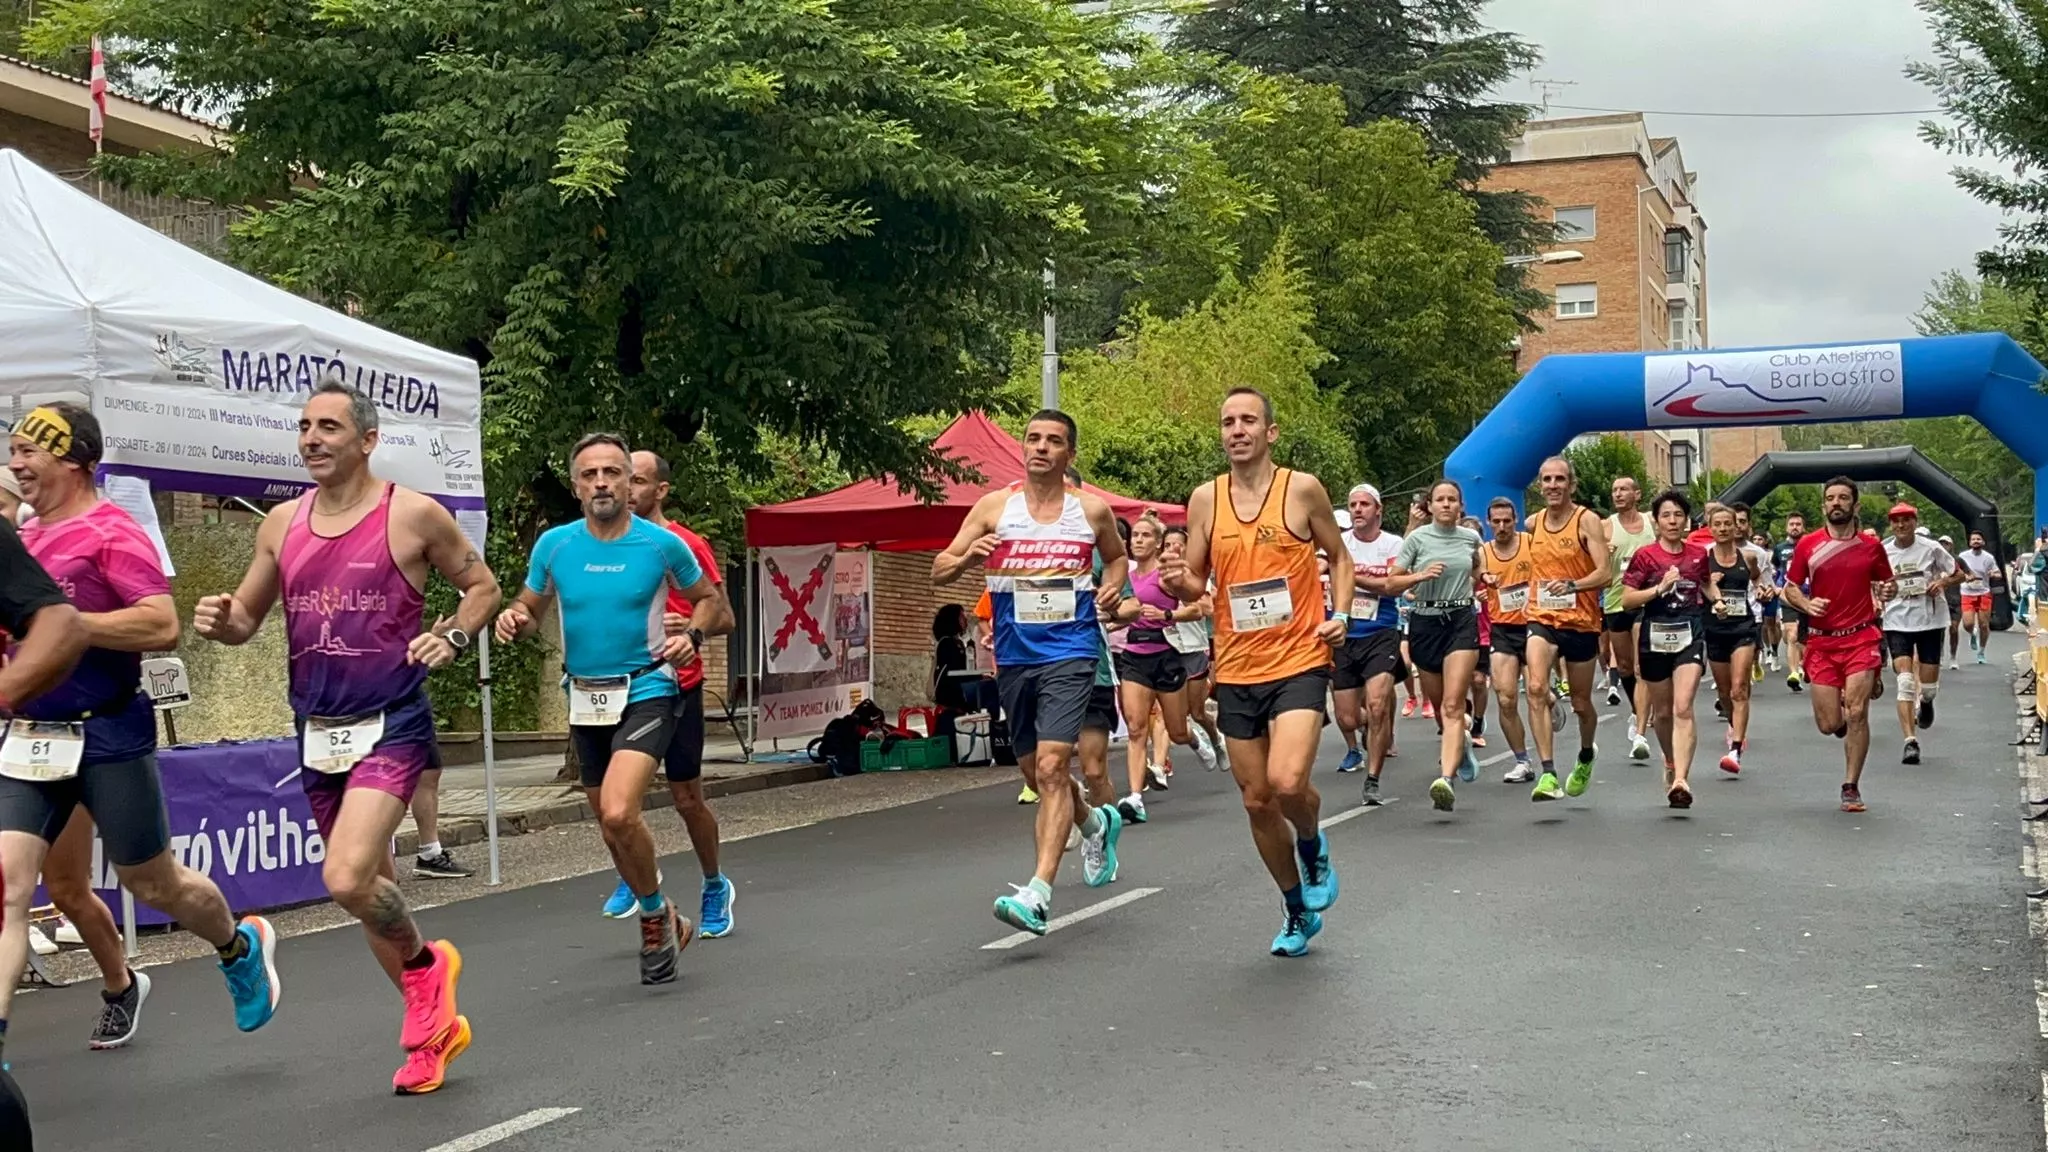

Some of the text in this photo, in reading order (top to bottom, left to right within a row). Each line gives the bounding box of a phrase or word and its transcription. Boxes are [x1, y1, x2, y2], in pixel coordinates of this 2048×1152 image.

[1769, 350, 1894, 367] Club Atletismo
[1771, 366, 1895, 389] Barbastro
[104, 396, 149, 414] DIUMENGE
[155, 403, 166, 415] 27
[187, 407, 207, 420] 2024
[253, 414, 284, 431] Vithas
[105, 436, 149, 452] DISSABTE
[187, 446, 207, 458] 2024
[212, 445, 246, 463] Curses
[1009, 541, 1081, 556] julián
[584, 563, 626, 572] land
[1040, 593, 1050, 605] 5
[1247, 597, 1267, 611] 21
[1665, 633, 1678, 641] 23
[590, 694, 608, 706] 60
[329, 729, 352, 746] 62
[31, 741, 51, 756] 61
